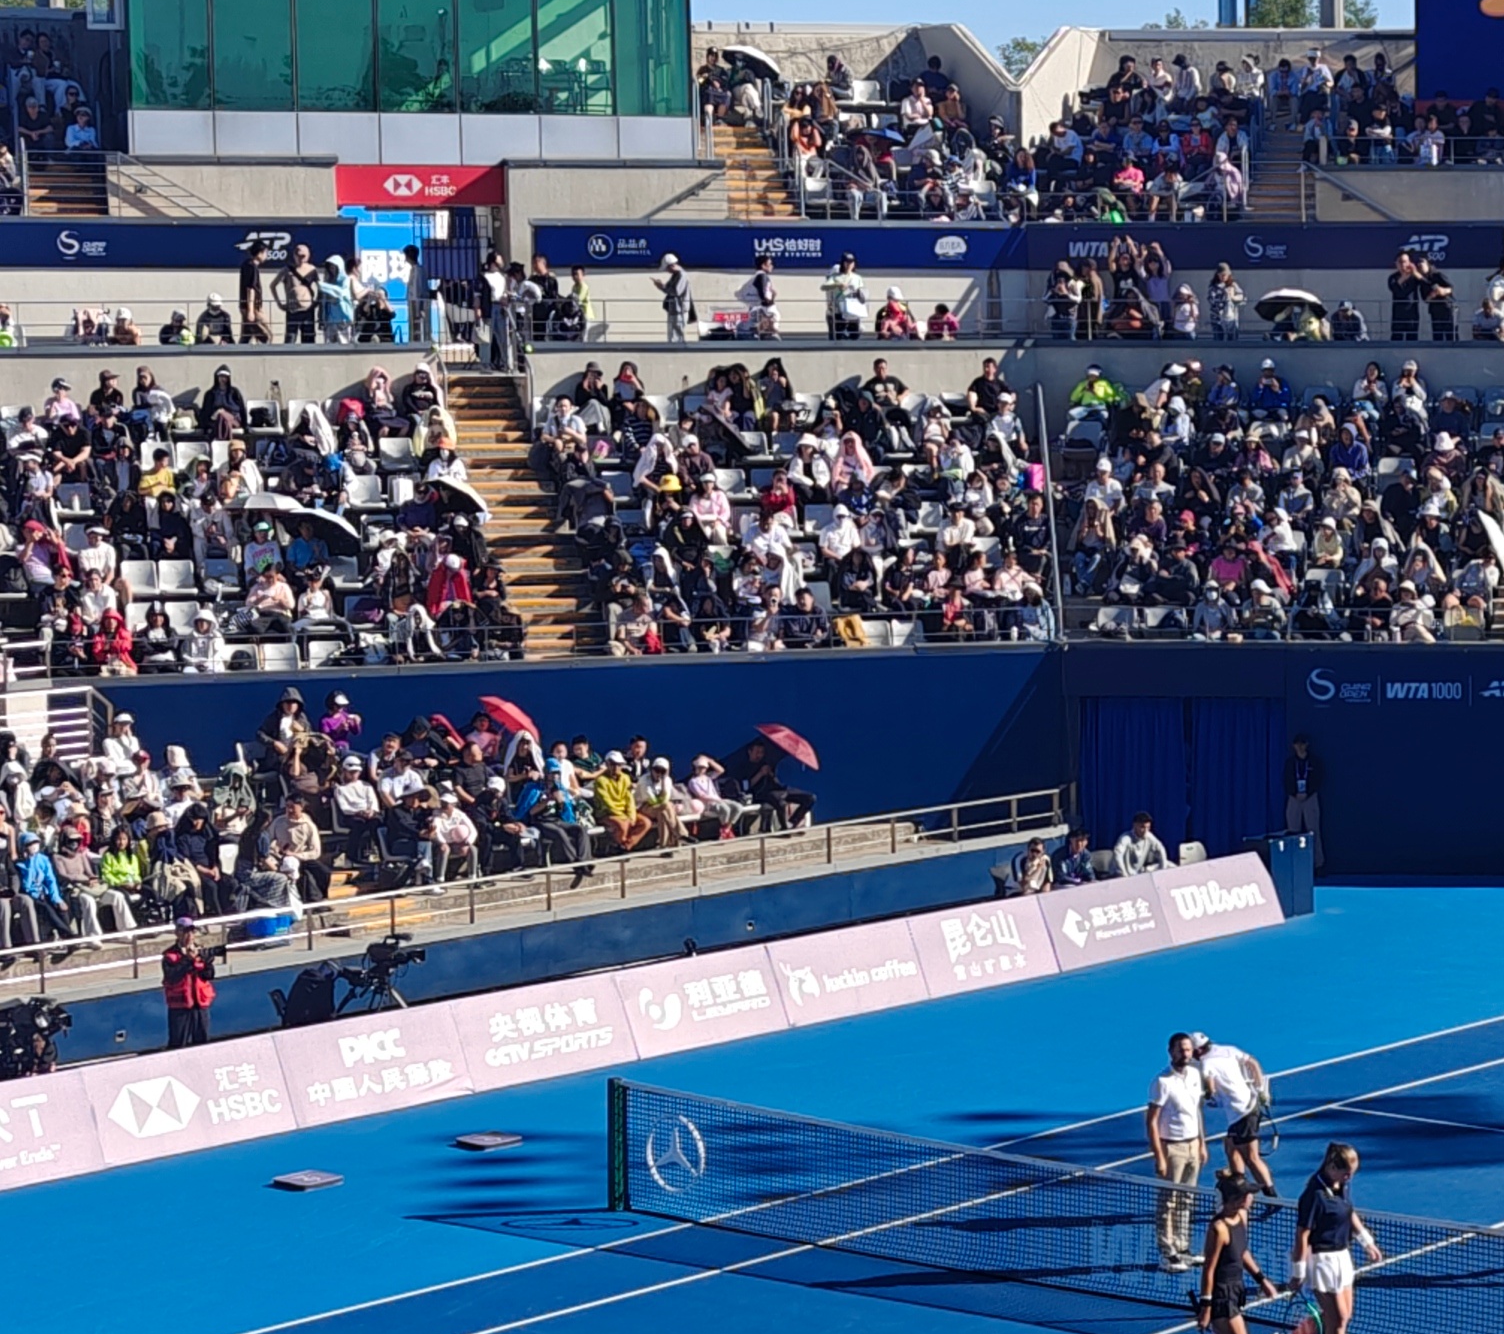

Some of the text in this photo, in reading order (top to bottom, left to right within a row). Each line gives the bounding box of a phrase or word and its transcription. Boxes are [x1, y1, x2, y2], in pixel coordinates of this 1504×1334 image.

[425, 185, 457, 196] HSBC
[234, 232, 291, 250] ATP
[1068, 242, 1109, 257] WTA
[1400, 235, 1449, 251] ATP
[1387, 682, 1461, 698] WTA 1000
[1089, 898, 1152, 928] 嘉实基金
[1170, 880, 1267, 920] Wilson
[940, 910, 1026, 963] 昆仑山
[683, 970, 767, 1008] 利亚德
[823, 959, 917, 993] luckin coffee
[489, 998, 598, 1042] 央视体育
[338, 1028, 406, 1067] PICC
[531, 1026, 613, 1060] SPORTS
[214, 1063, 259, 1091] 汇丰
[207, 1089, 282, 1124] HSBC
